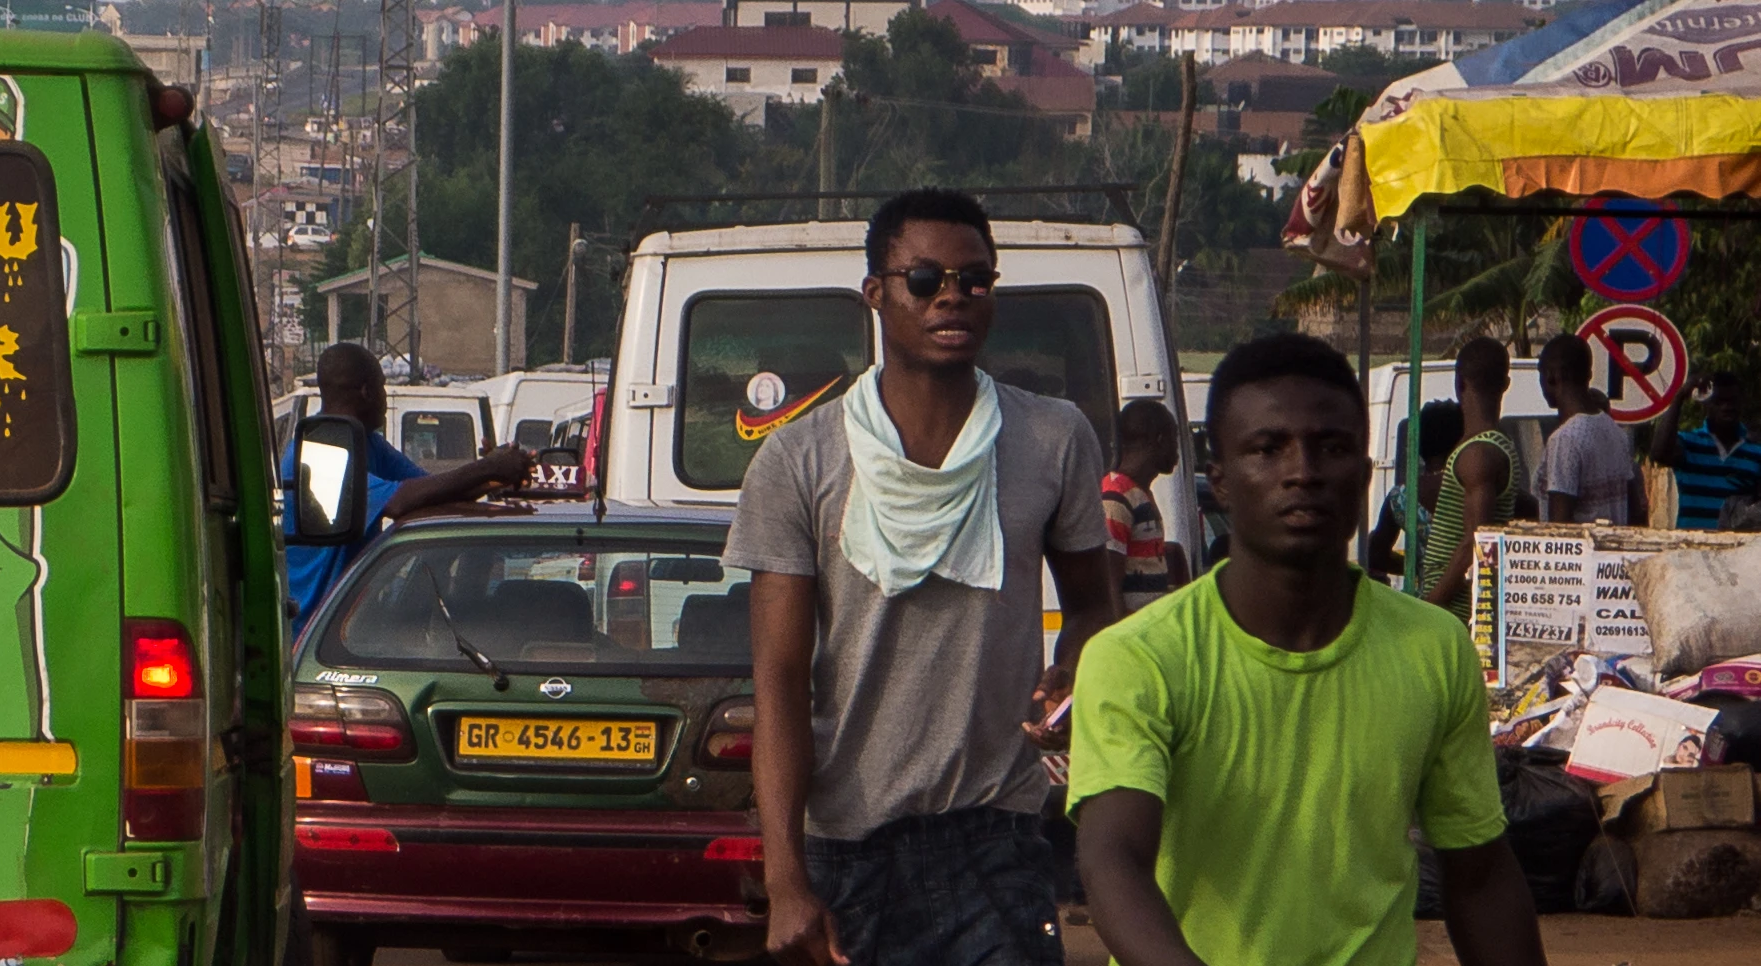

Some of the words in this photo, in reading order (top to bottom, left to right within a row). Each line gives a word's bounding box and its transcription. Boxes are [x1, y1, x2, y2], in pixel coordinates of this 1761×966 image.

[1608, 328, 1663, 400] P
[531, 464, 579, 484] AXI
[1545, 541, 1583, 556] 8HRS
[1509, 559, 1541, 571] WEEK
[1544, 561, 1552, 571] &
[1555, 562, 1583, 572] EARN
[1540, 576, 1547, 585] A
[1548, 576, 1586, 586] MONTH.
[1531, 593, 1555, 605] 658
[1558, 594, 1582, 606] 754
[1596, 586, 1637, 600] WAN
[315, 670, 379, 685] Almera
[467, 723, 499, 749] GR
[634, 742, 651, 754] GH
